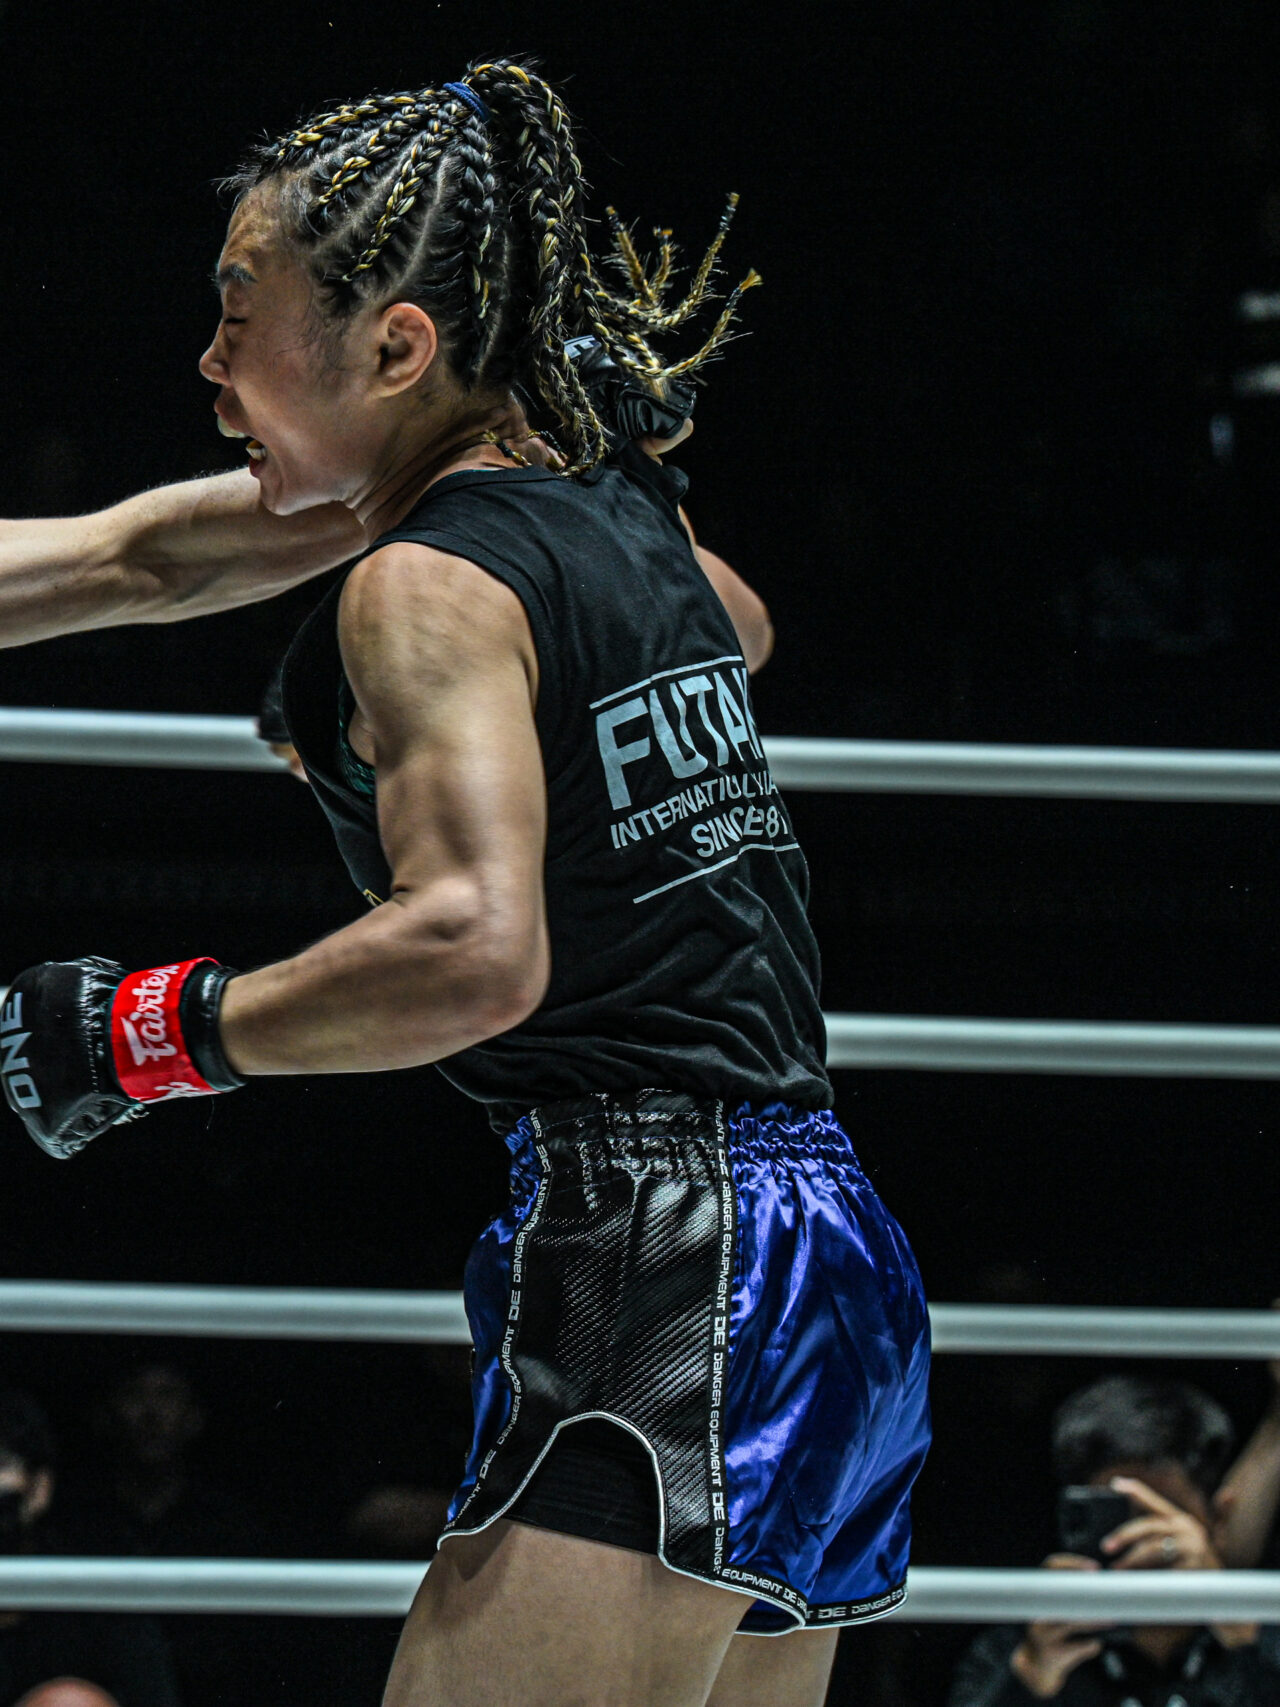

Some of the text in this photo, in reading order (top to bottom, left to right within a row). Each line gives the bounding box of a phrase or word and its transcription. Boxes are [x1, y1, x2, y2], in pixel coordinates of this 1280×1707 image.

[0, 991, 42, 1110] ONE
[716, 1233, 732, 1310] EQUIPMENT
[508, 1289, 521, 1321] DE
[713, 1315, 727, 1346] DE
[709, 1410, 722, 1487] EQUIPMENT
[712, 1492, 726, 1522] DE
[722, 1568, 783, 1594] EQUIPMENT
[818, 1606, 848, 1619] DE
